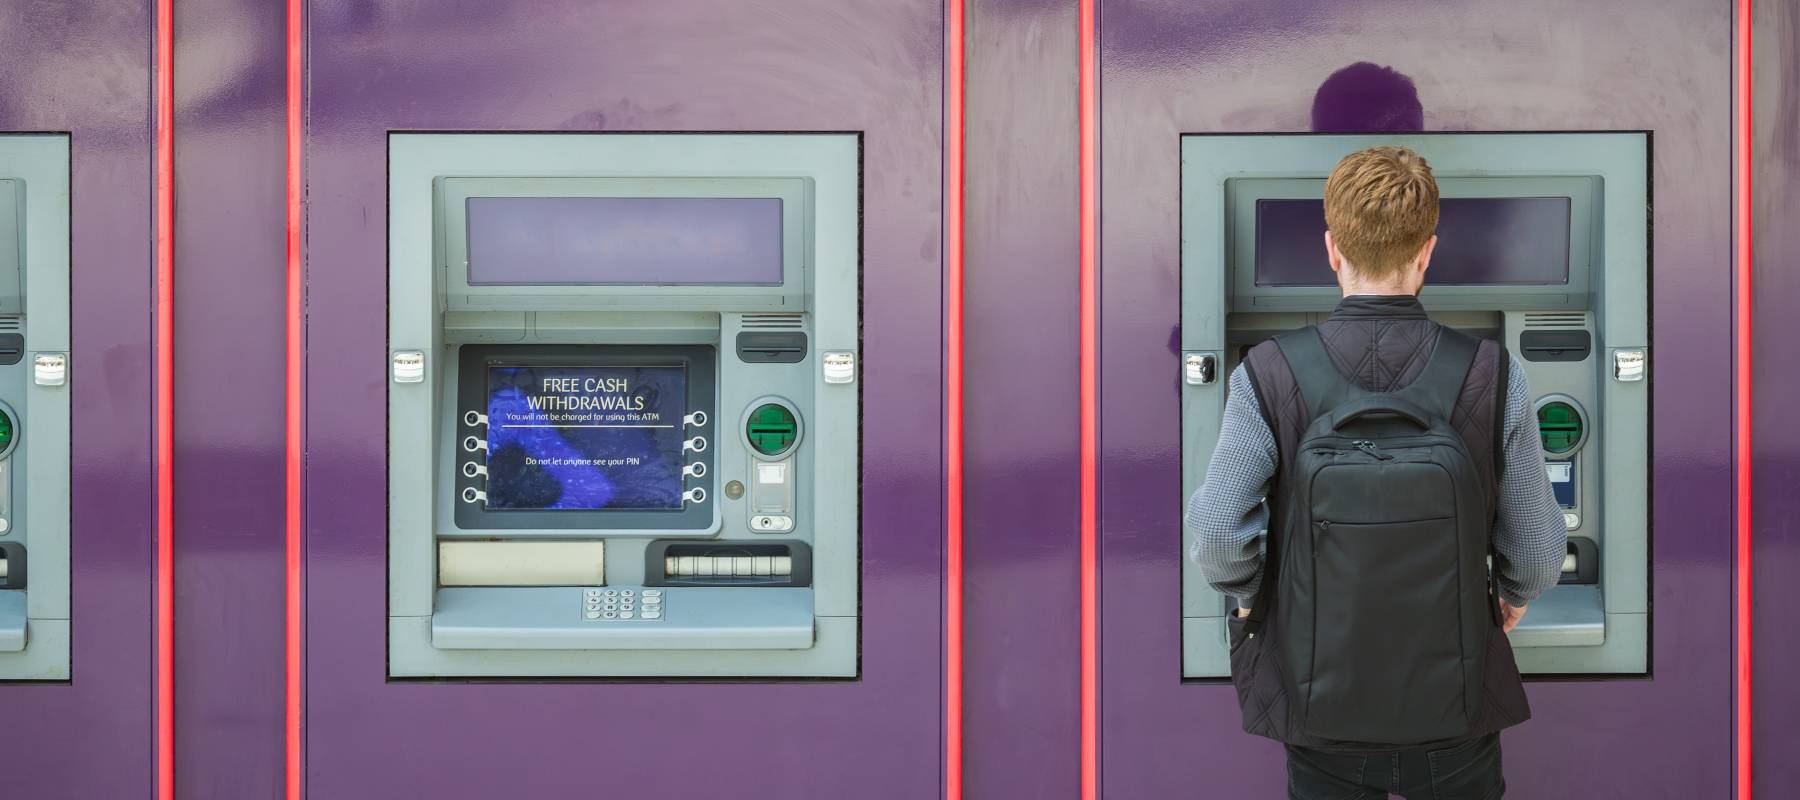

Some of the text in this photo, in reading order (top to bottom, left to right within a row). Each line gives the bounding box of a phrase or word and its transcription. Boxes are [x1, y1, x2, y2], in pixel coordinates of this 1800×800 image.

[543, 378, 628, 393] FREE CASH
[526, 395, 645, 411] WITHDRAWALS
[506, 412, 660, 423] You will not be charged for using this ATM
[525, 457, 537, 465] Do
[538, 457, 551, 466] not
[552, 457, 562, 466] let
[563, 458, 592, 467] anyone
[607, 459, 625, 467] your
[626, 457, 640, 465] PIN
